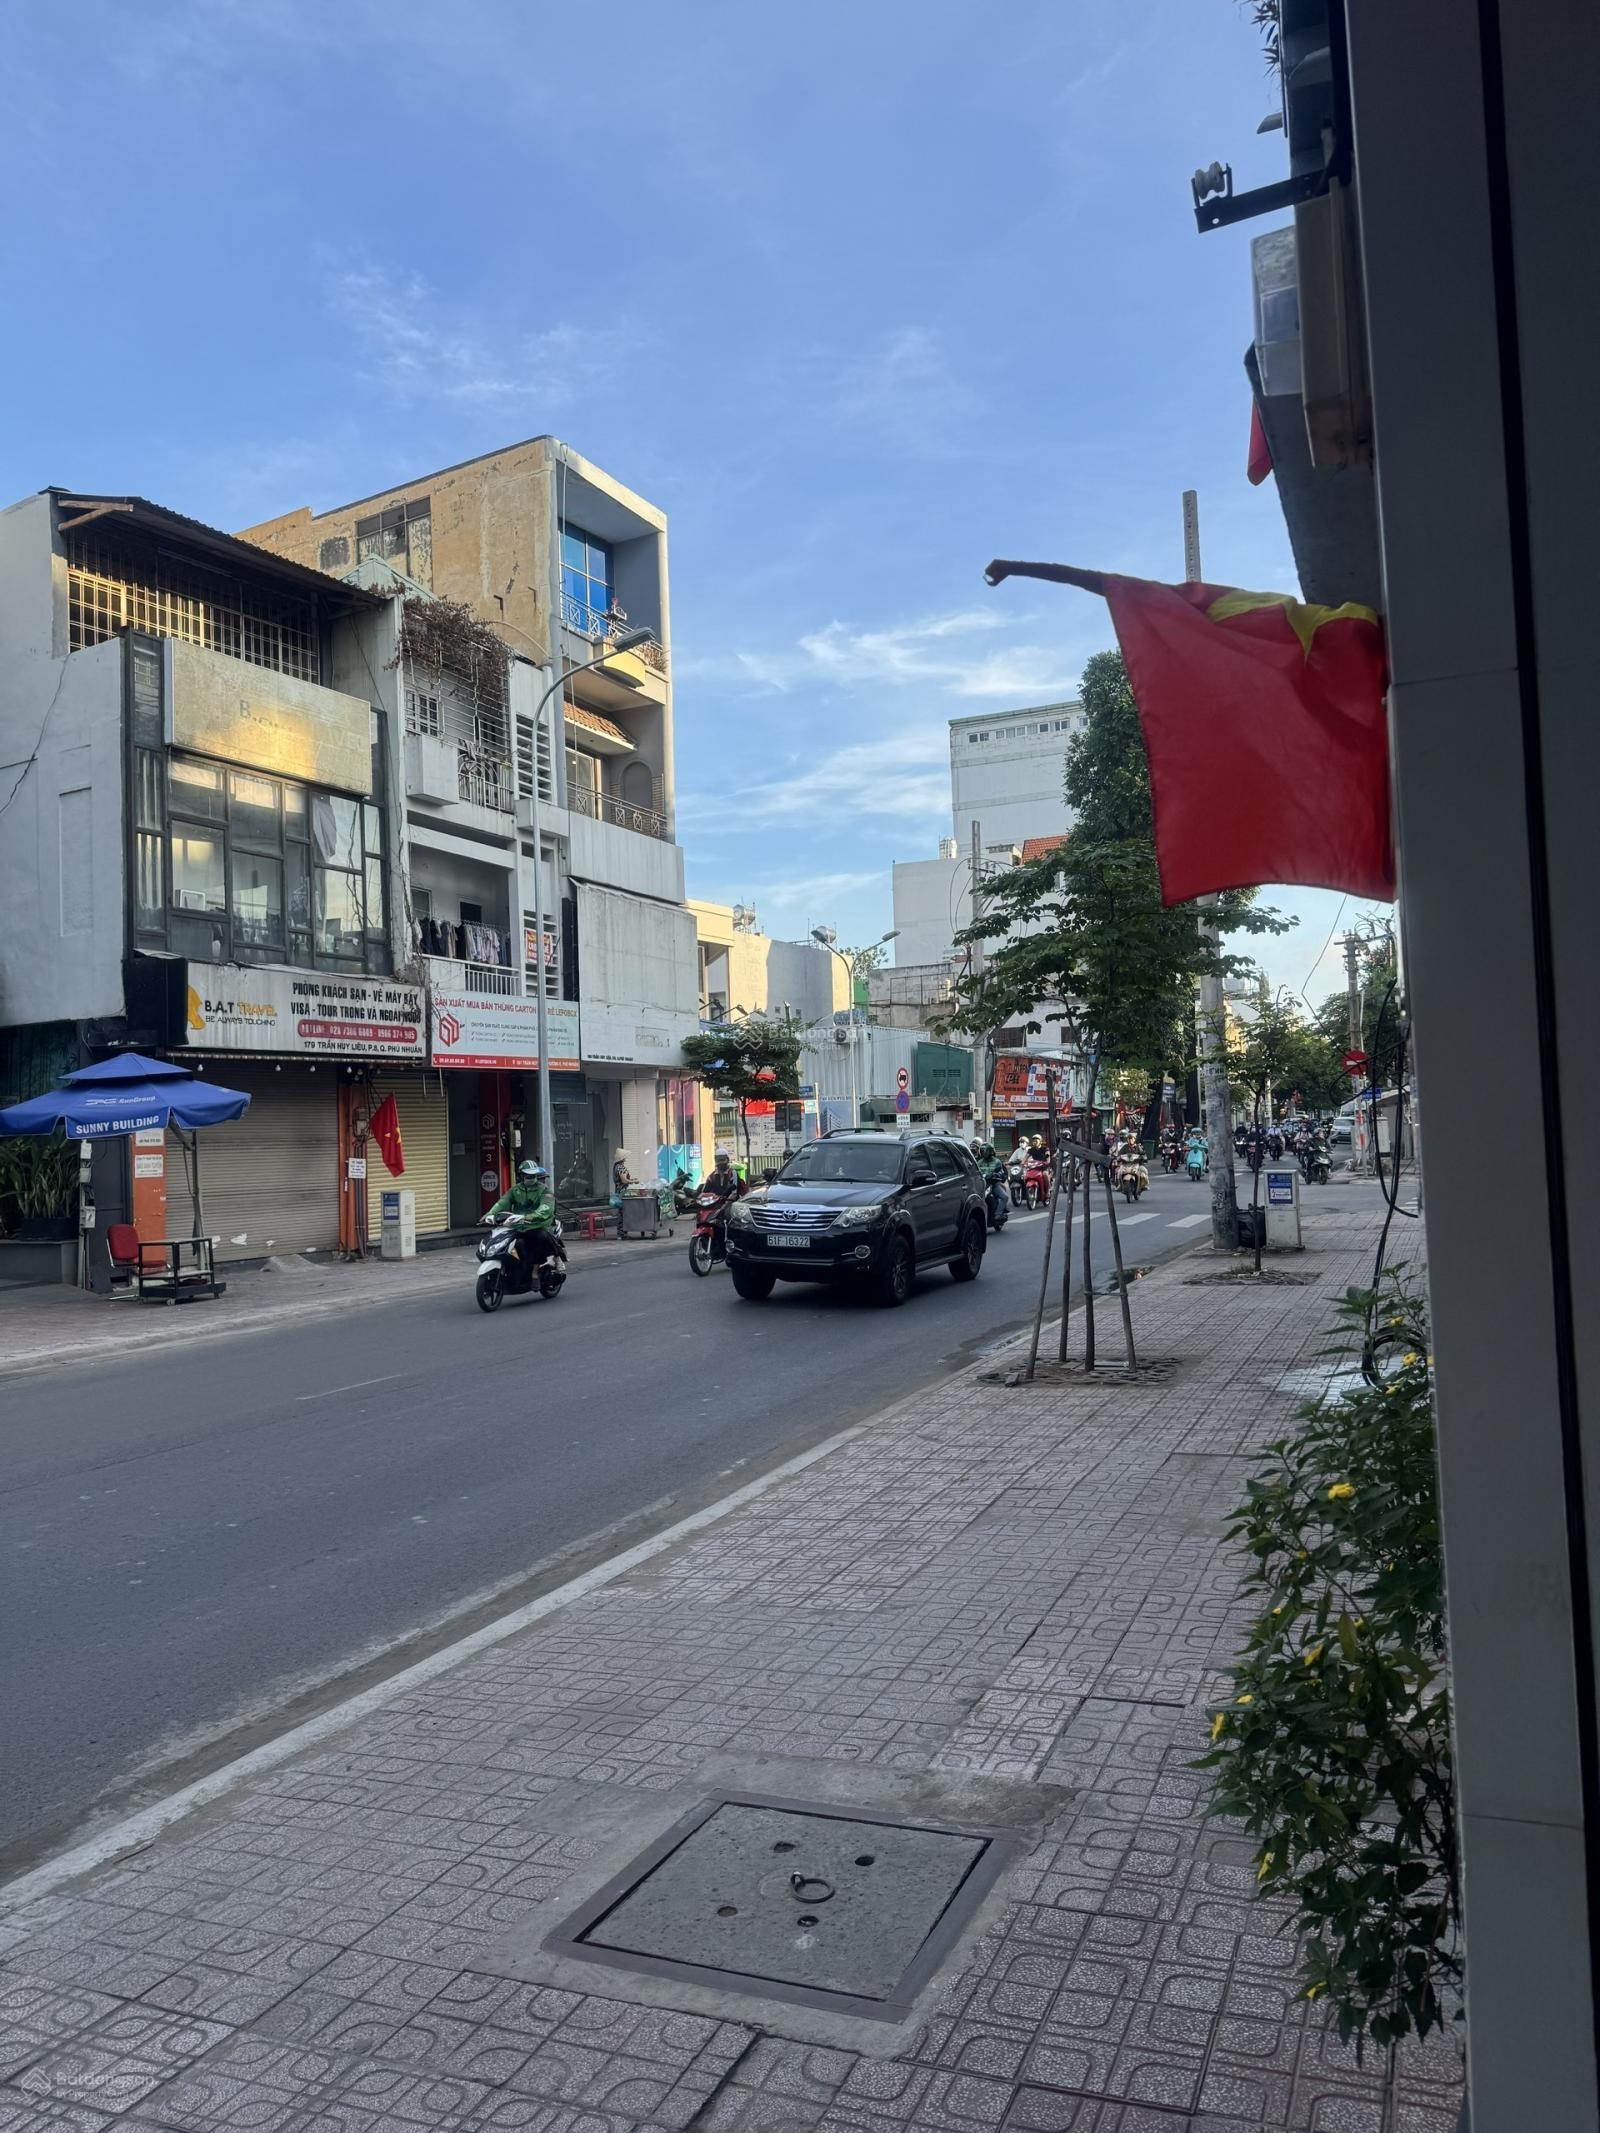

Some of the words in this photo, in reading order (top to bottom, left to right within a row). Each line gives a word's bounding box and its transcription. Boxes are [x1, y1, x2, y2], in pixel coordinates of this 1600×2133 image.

[293, 980, 319, 996] PHÒNG
[322, 984, 347, 999] KHÁCH
[350, 988, 366, 1003] SẠN
[385, 989, 401, 1004] MÁY
[205, 1000, 234, 1014] B.A.T
[237, 1002, 277, 1017] TRAVEL
[291, 1002, 310, 1016] VISA
[317, 1004, 338, 1018] TOUR
[340, 1006, 364, 1020] TRONG
[367, 1006, 377, 1020] VÀ
[449, 998, 465, 1008] XUẤT
[466, 1000, 480, 1009] MUA
[481, 1000, 493, 1010] BÁN
[494, 1002, 514, 1012] THÙNG
[515, 1004, 537, 1014] CARTON
[218, 1017, 242, 1025] ALWAYS
[245, 1018, 276, 1027] TOUCHING
[304, 1041, 316, 1049] 179
[318, 1040, 335, 1050] TRẦN
[337, 1043, 350, 1051] HUY
[388, 1045, 400, 1054] PHÚ
[402, 1046, 422, 1055] NHUẬN
[76, 1121, 109, 1134] SUNNY
[113, 1115, 159, 1130] BUILDING
